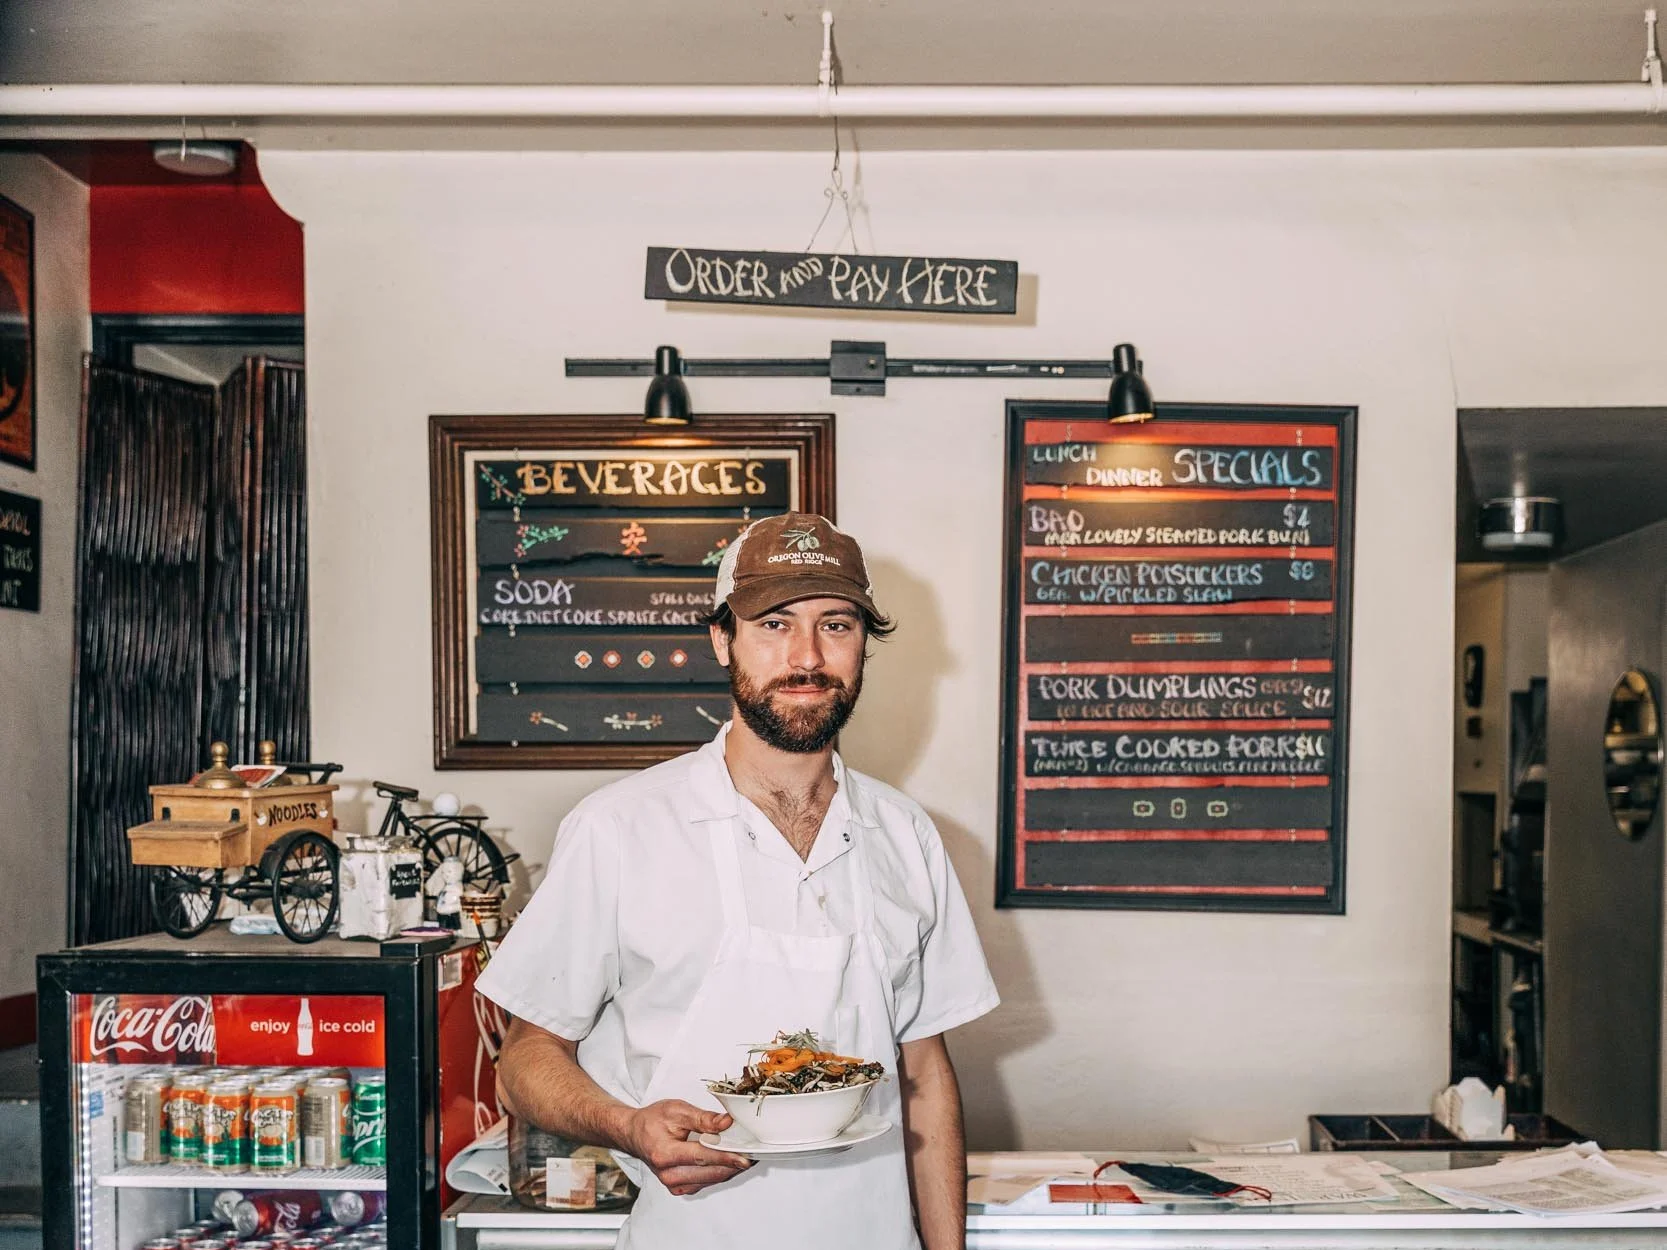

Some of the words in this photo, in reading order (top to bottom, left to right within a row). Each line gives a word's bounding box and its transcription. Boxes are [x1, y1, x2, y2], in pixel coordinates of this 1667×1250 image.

[665, 247, 776, 299] ORDER
[779, 256, 824, 296] AND
[828, 256, 891, 303] PAY
[897, 257, 998, 306] HERE
[1033, 444, 1097, 463] LUNCH
[516, 460, 767, 496] BEVERAGES
[1086, 467, 1164, 487] DINNER
[1171, 448, 1321, 487] SPECIALS
[1028, 504, 1085, 533] BAO
[1083, 526, 1144, 546] LOVELY
[1145, 526, 1218, 545] STEAMED
[1218, 527, 1265, 546] PORK
[767, 551, 801, 564] OREGON
[802, 551, 825, 562] OLIVE
[825, 555, 841, 567] MILL
[1031, 560, 1131, 586] CHICKEN
[494, 578, 576, 606] SODA
[1039, 675, 1100, 700] PORK
[1106, 674, 1257, 700] DUMPLINGS
[1031, 735, 1108, 759] TWICE
[1115, 734, 1221, 759] COOKED
[1225, 734, 1296, 759] PORK
[268, 802, 317, 827] NOODLES
[89, 994, 216, 1056] Coca-Cola
[250, 1019, 291, 1034] enjoy
[319, 1019, 341, 1034] ice
[343, 1019, 375, 1034] cold
